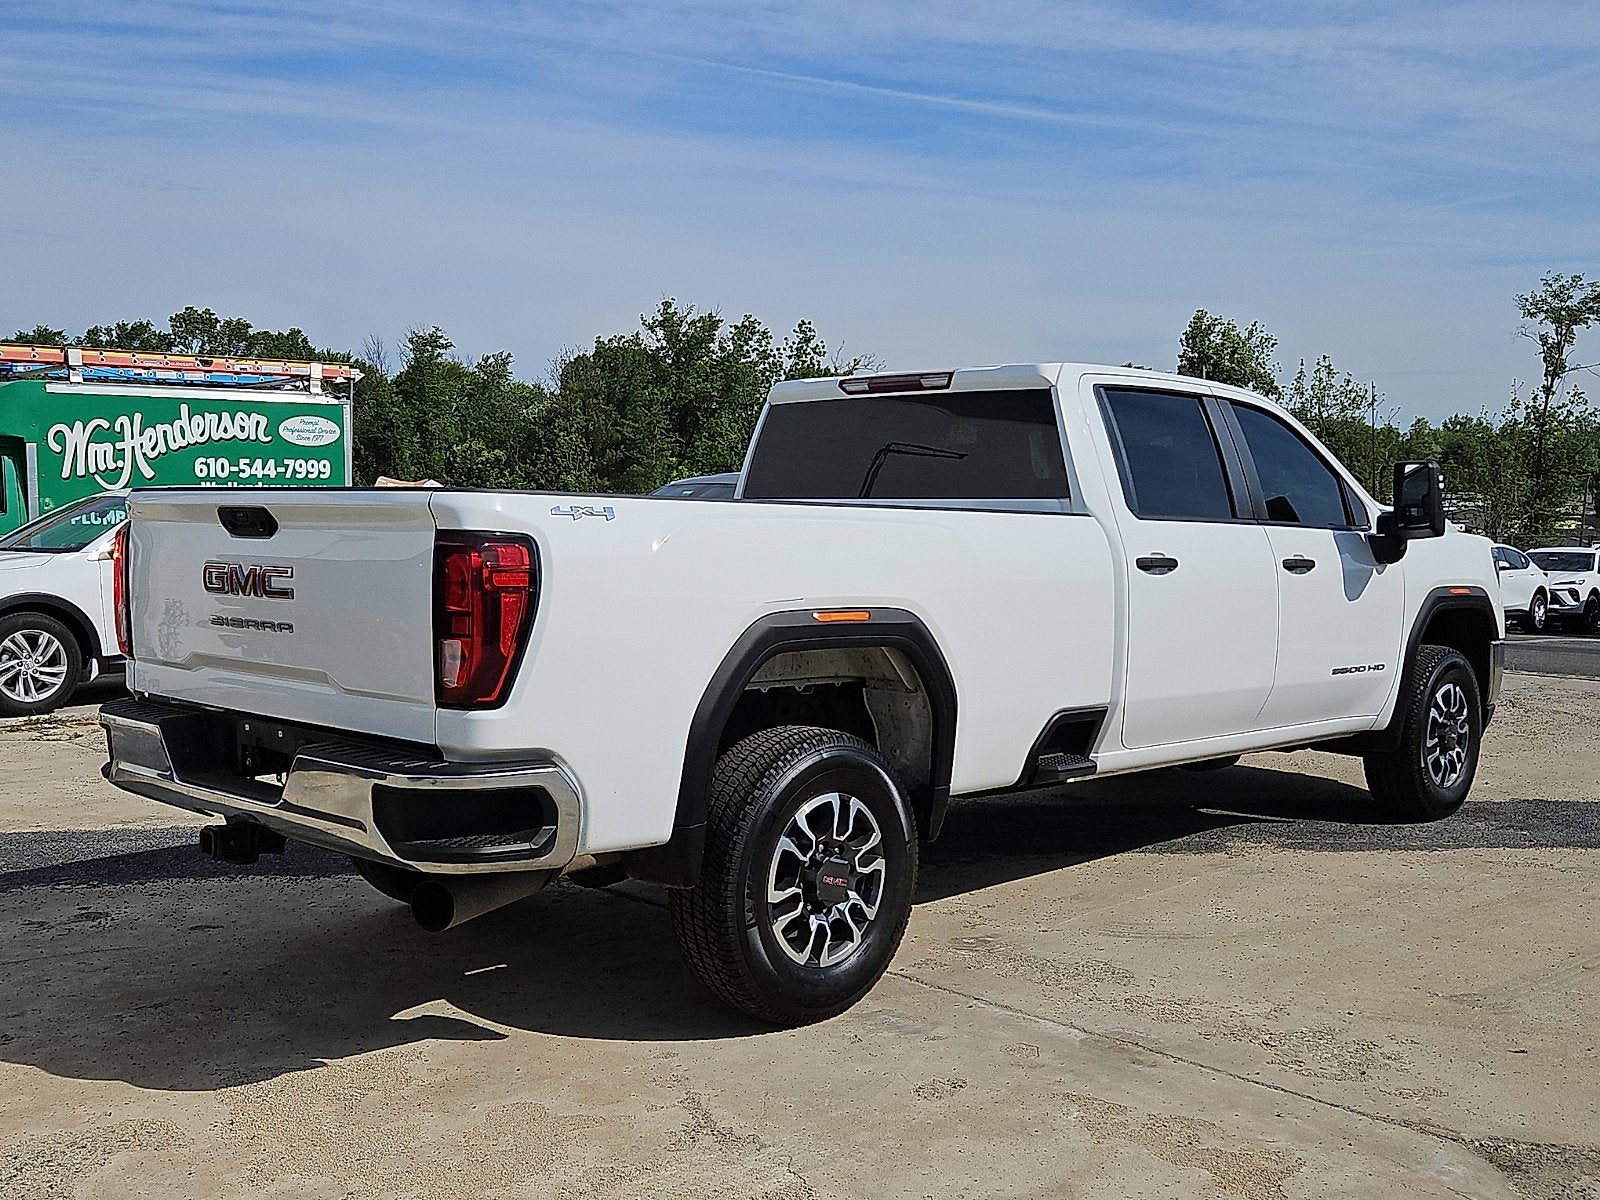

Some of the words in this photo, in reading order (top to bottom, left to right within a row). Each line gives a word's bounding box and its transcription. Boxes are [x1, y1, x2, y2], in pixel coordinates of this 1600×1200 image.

[94, 403, 272, 489] Henderson
[194, 457, 331, 479] 610-544-7999
[202, 561, 295, 600] GMC
[209, 614, 294, 634] SIERRA
